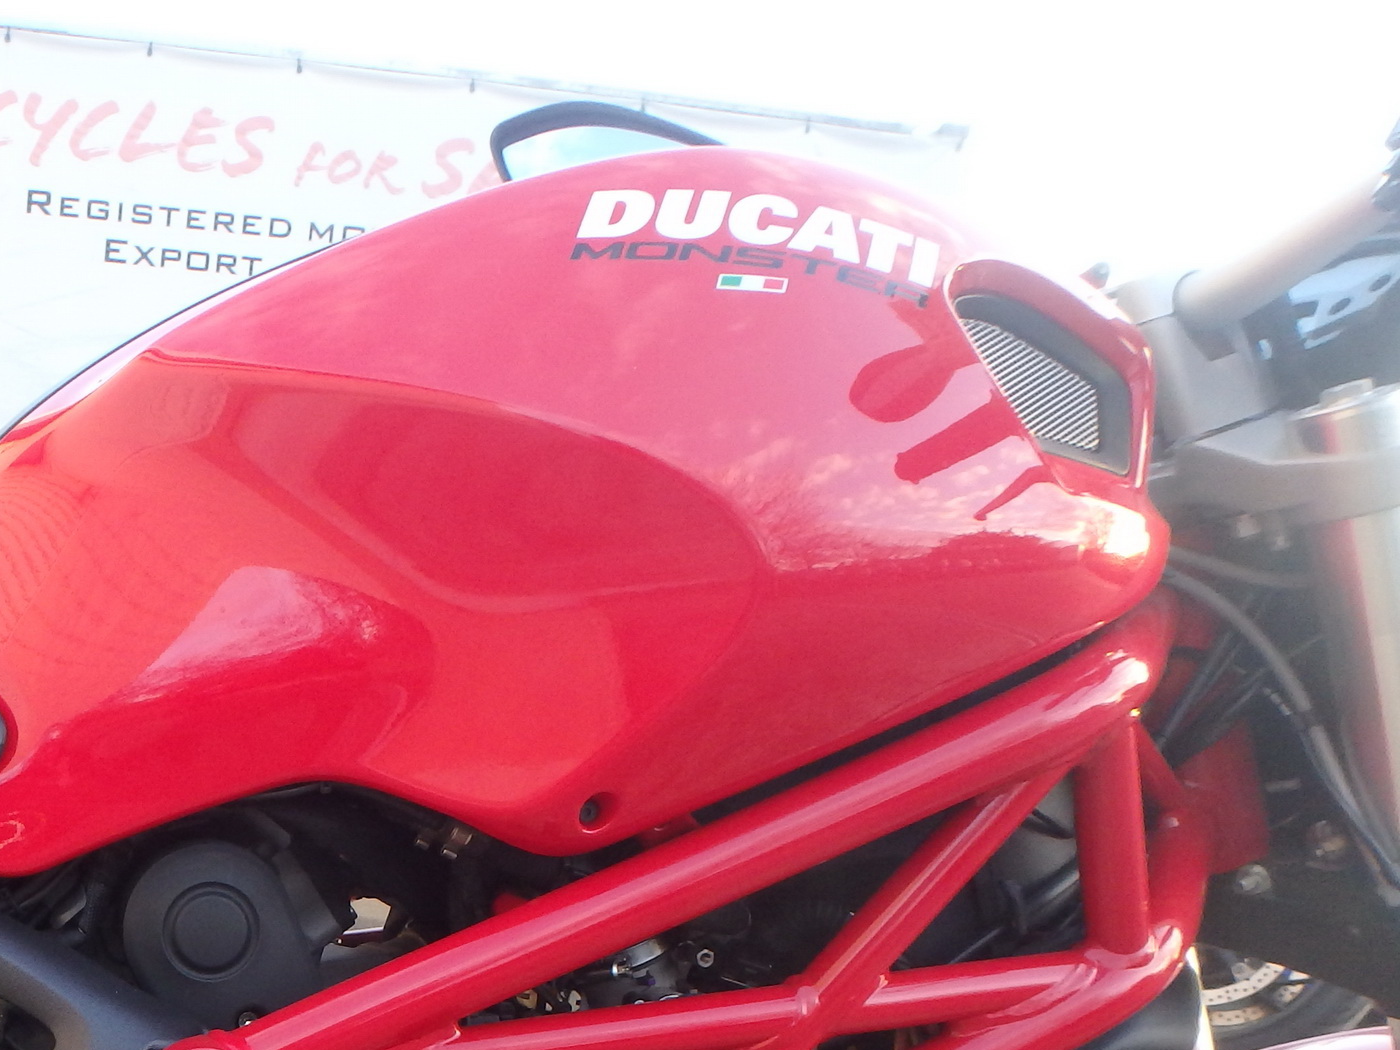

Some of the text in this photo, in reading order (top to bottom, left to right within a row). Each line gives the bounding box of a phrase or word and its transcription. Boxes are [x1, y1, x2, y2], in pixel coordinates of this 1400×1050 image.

[294, 141, 405, 196] FOR
[26, 189, 293, 239] REGISTERED
[575, 188, 941, 289] DUCATI
[103, 238, 263, 277] EXPORT
[569, 240, 931, 309] MONSTER
